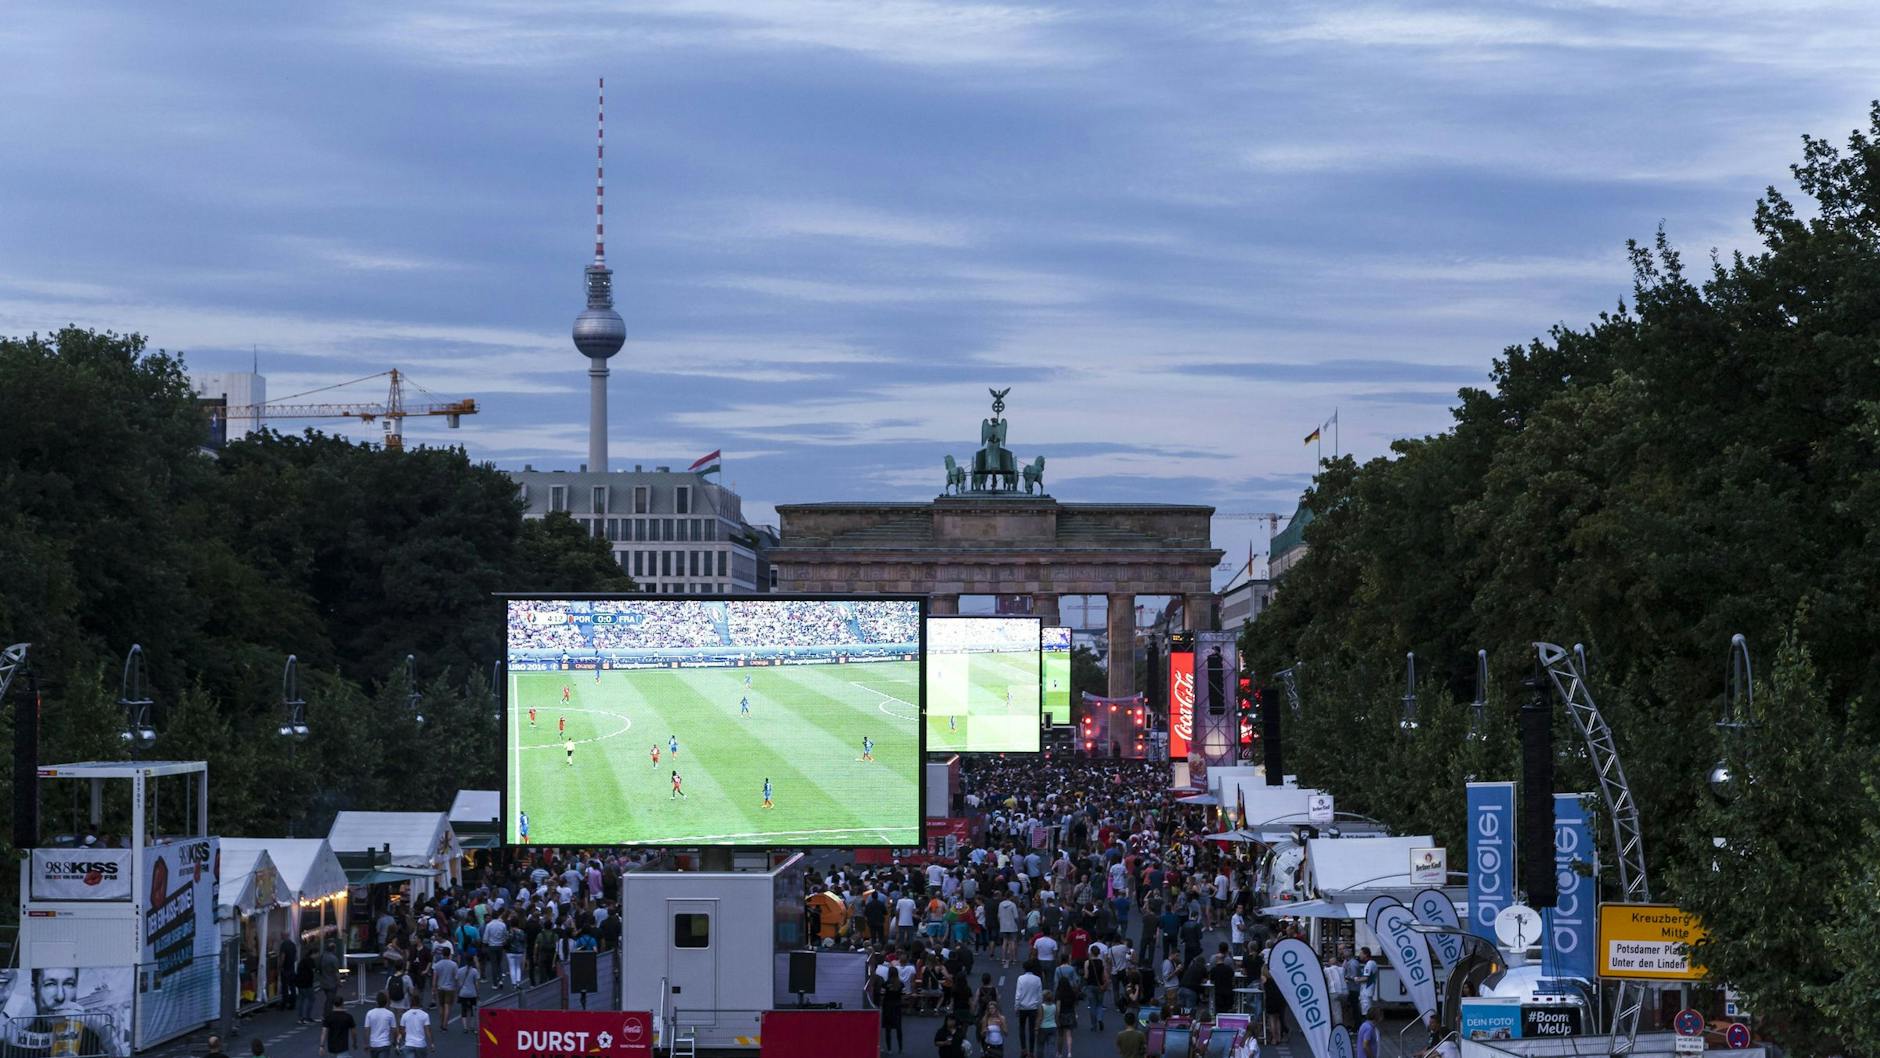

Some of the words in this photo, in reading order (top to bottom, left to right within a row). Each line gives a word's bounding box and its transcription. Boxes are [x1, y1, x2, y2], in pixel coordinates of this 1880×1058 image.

[574, 615, 590, 623] POR
[597, 615, 612, 623] 0:0
[618, 615, 635, 623] FRA
[527, 663, 547, 671] 2016
[1478, 804, 1503, 927] alcatel
[1632, 912, 1691, 926] Kreuzberg
[1661, 927, 1689, 939] Mitte
[1387, 916, 1430, 987] alcatel
[1616, 943, 1661, 955] Potsdamer
[1612, 957, 1635, 969] Unter
[1638, 957, 1655, 969] den
[1657, 957, 1685, 969] Linden
[1282, 950, 1328, 1031] alcatel
[1467, 1018, 1486, 1027] DEIN
[1488, 1017, 1514, 1026] FOTO!
[1528, 1011, 1570, 1023] #Boom
[1537, 1023, 1572, 1037] MeUp
[517, 1030, 589, 1052] DURST
